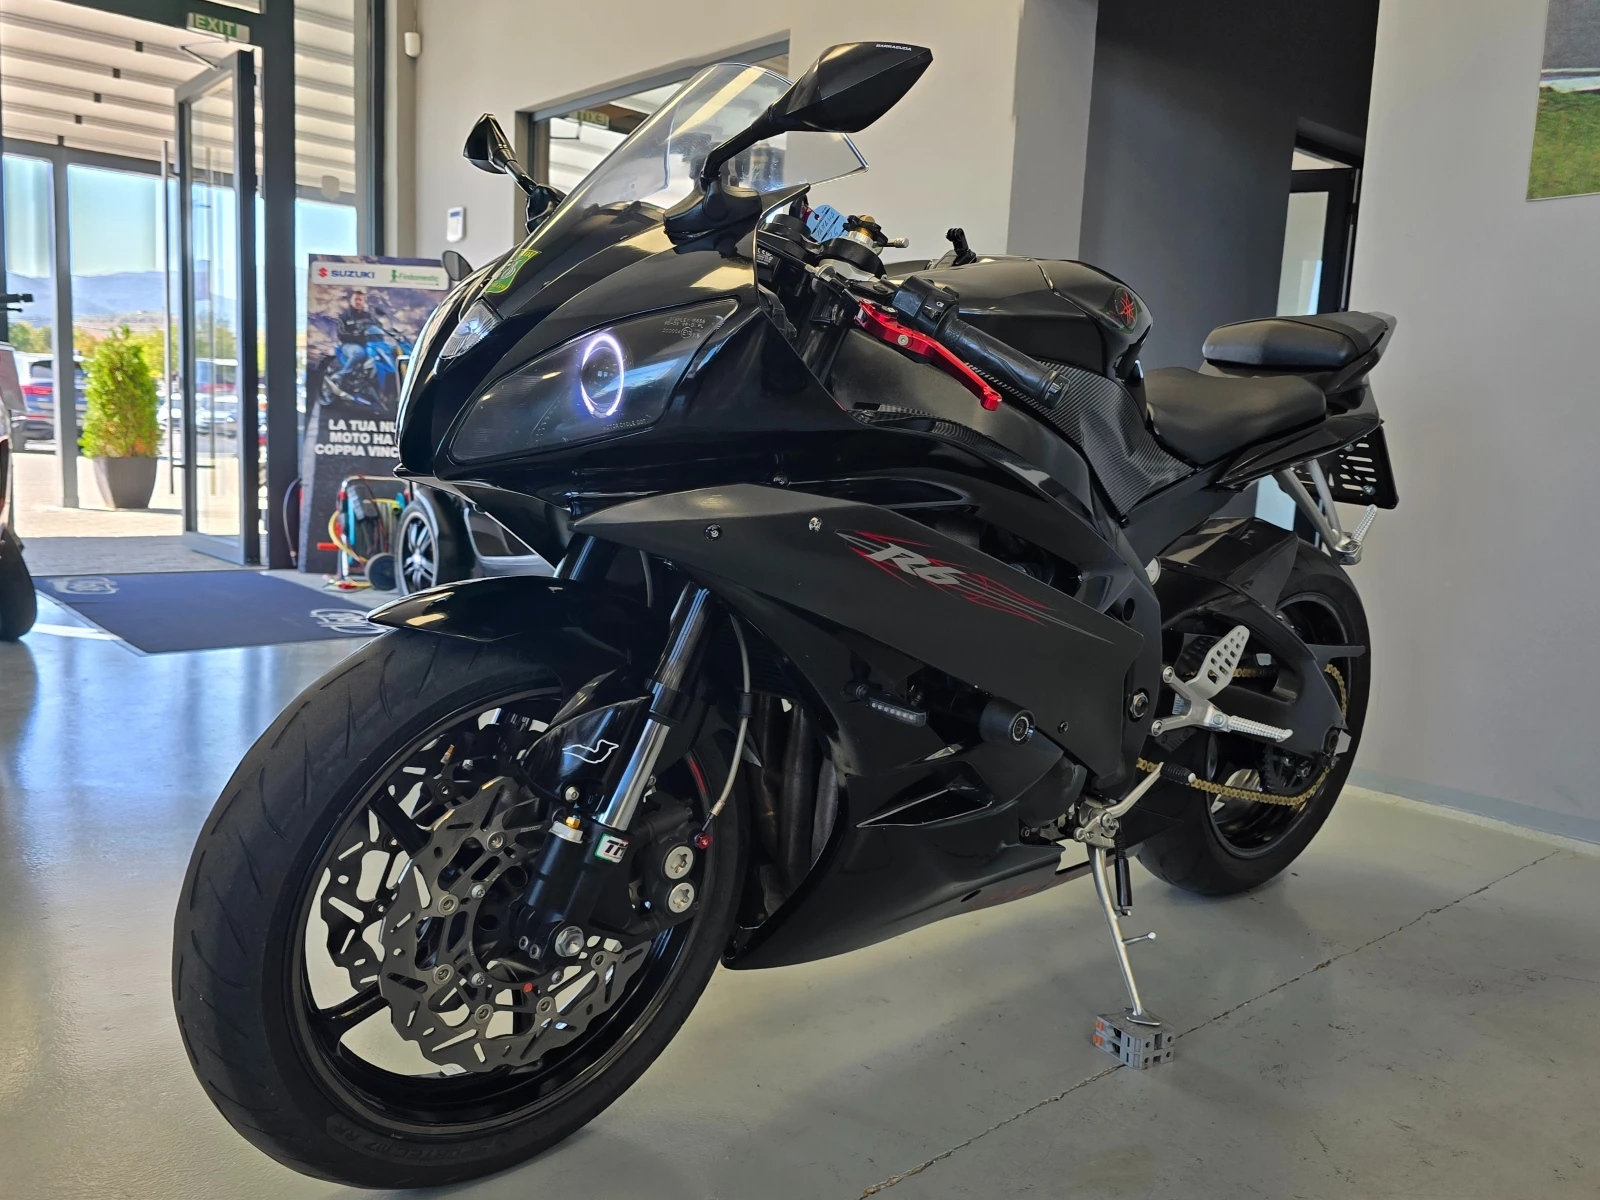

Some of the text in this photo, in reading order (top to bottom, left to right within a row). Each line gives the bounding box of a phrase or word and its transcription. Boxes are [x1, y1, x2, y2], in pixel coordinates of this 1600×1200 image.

[195, 14, 235, 36] EXIT
[331, 270, 375, 279] SUZUKI
[328, 419, 347, 430] LA
[349, 420, 378, 432] TUA
[329, 431, 393, 445] MOTO HA
[314, 443, 399, 458] COPPIA VINC
[864, 542, 967, 585] R6
